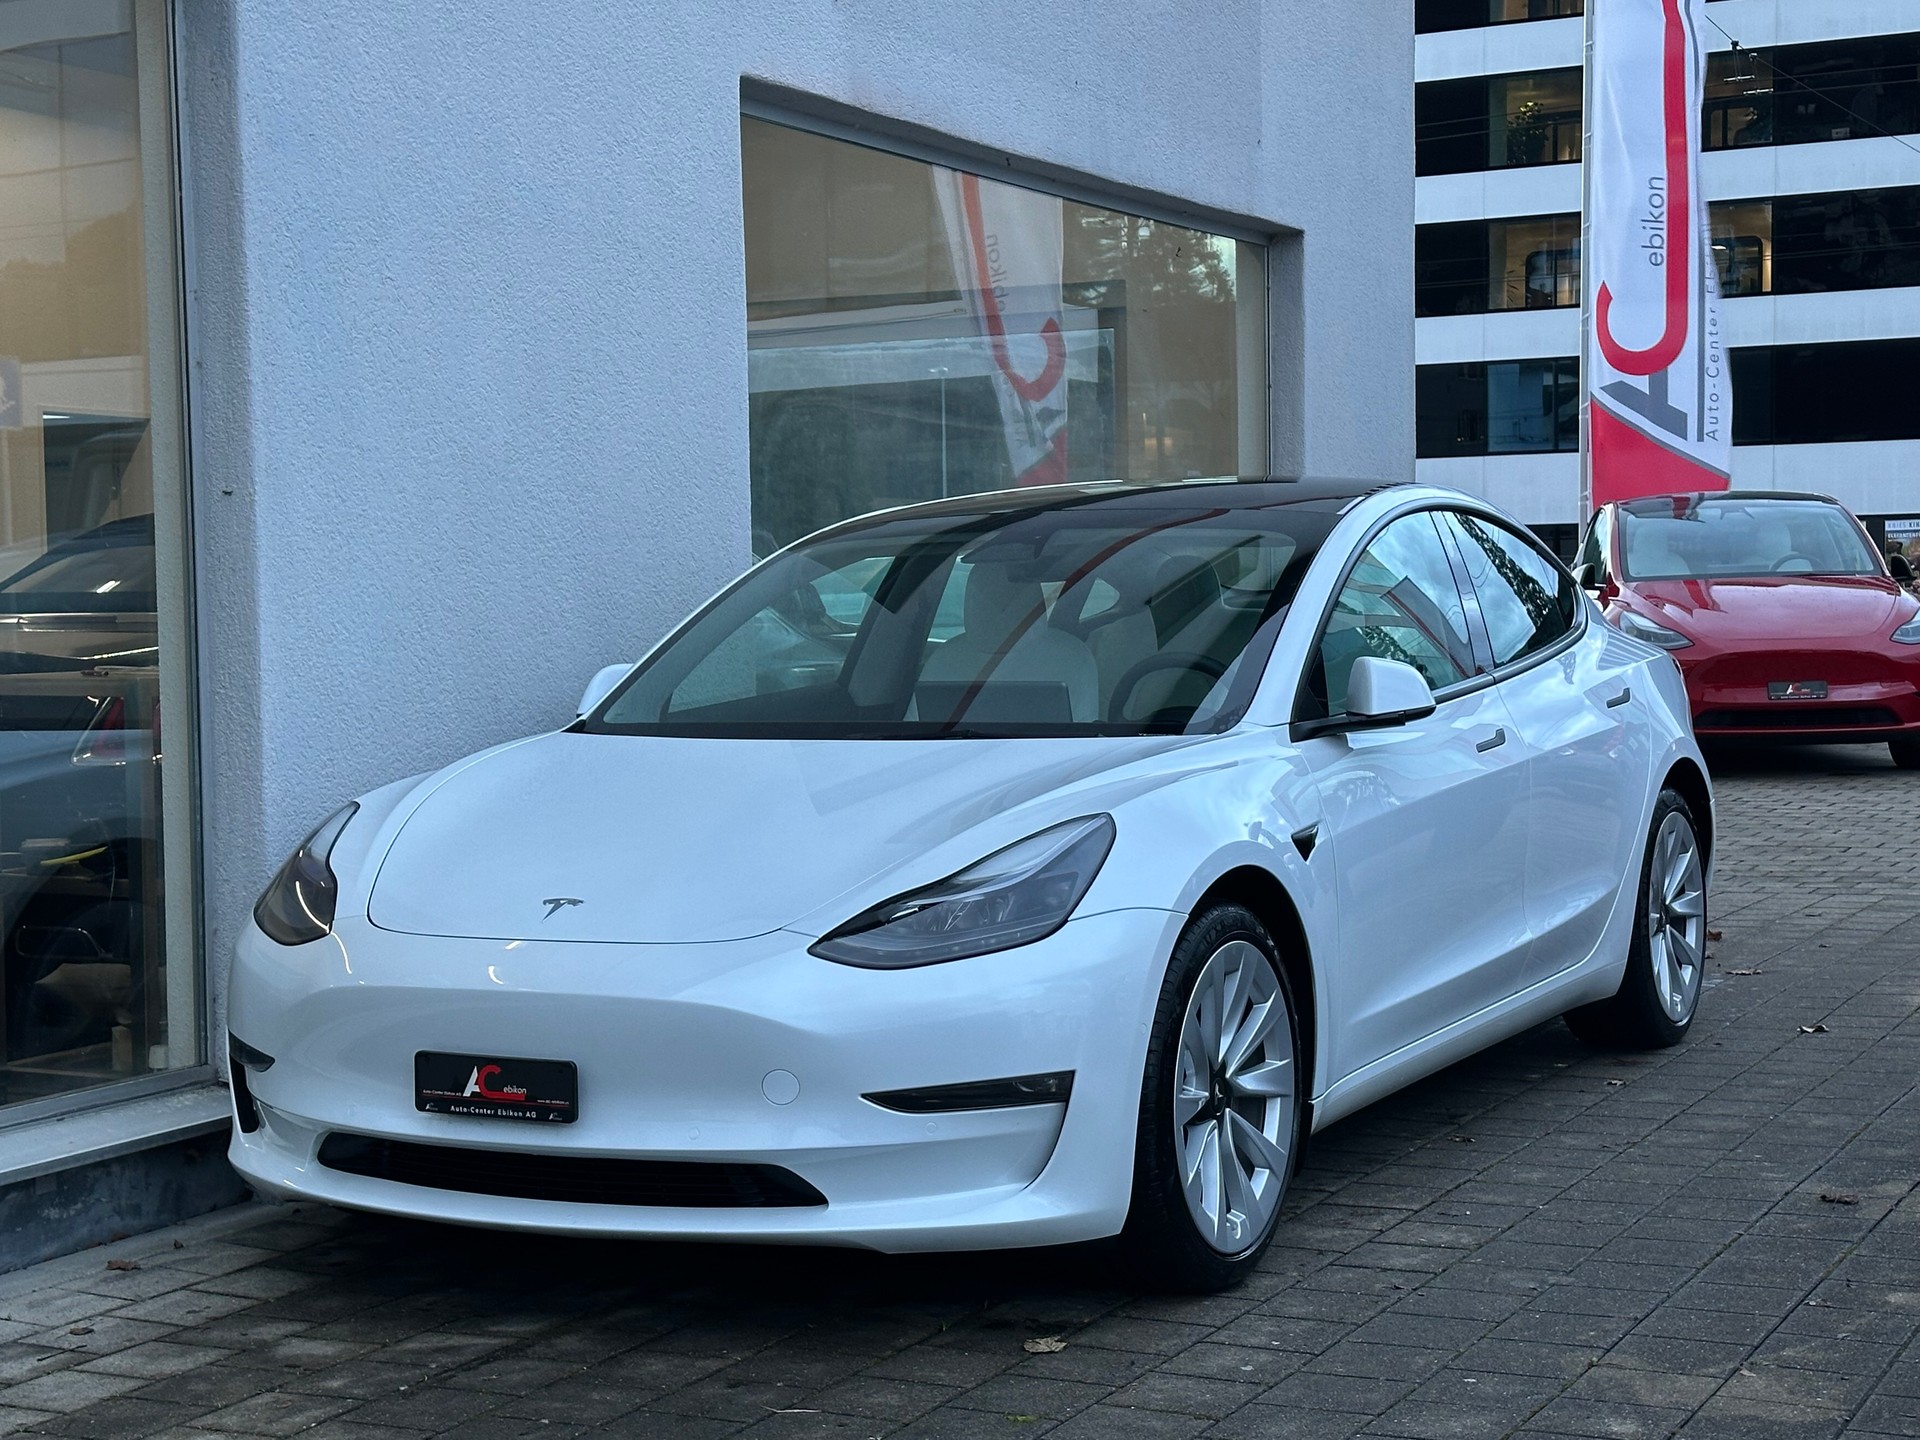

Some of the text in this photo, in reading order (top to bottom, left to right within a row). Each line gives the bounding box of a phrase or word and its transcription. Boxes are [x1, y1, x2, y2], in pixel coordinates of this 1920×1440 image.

[1641, 177, 1665, 268] ebikon
[1705, 307, 1720, 442] Auto-Center
[463, 1065, 503, 1100] AC
[503, 1085, 527, 1095] ebikon
[450, 1105, 495, 1115] Auto-Center
[497, 1108, 523, 1117] Ebikon
